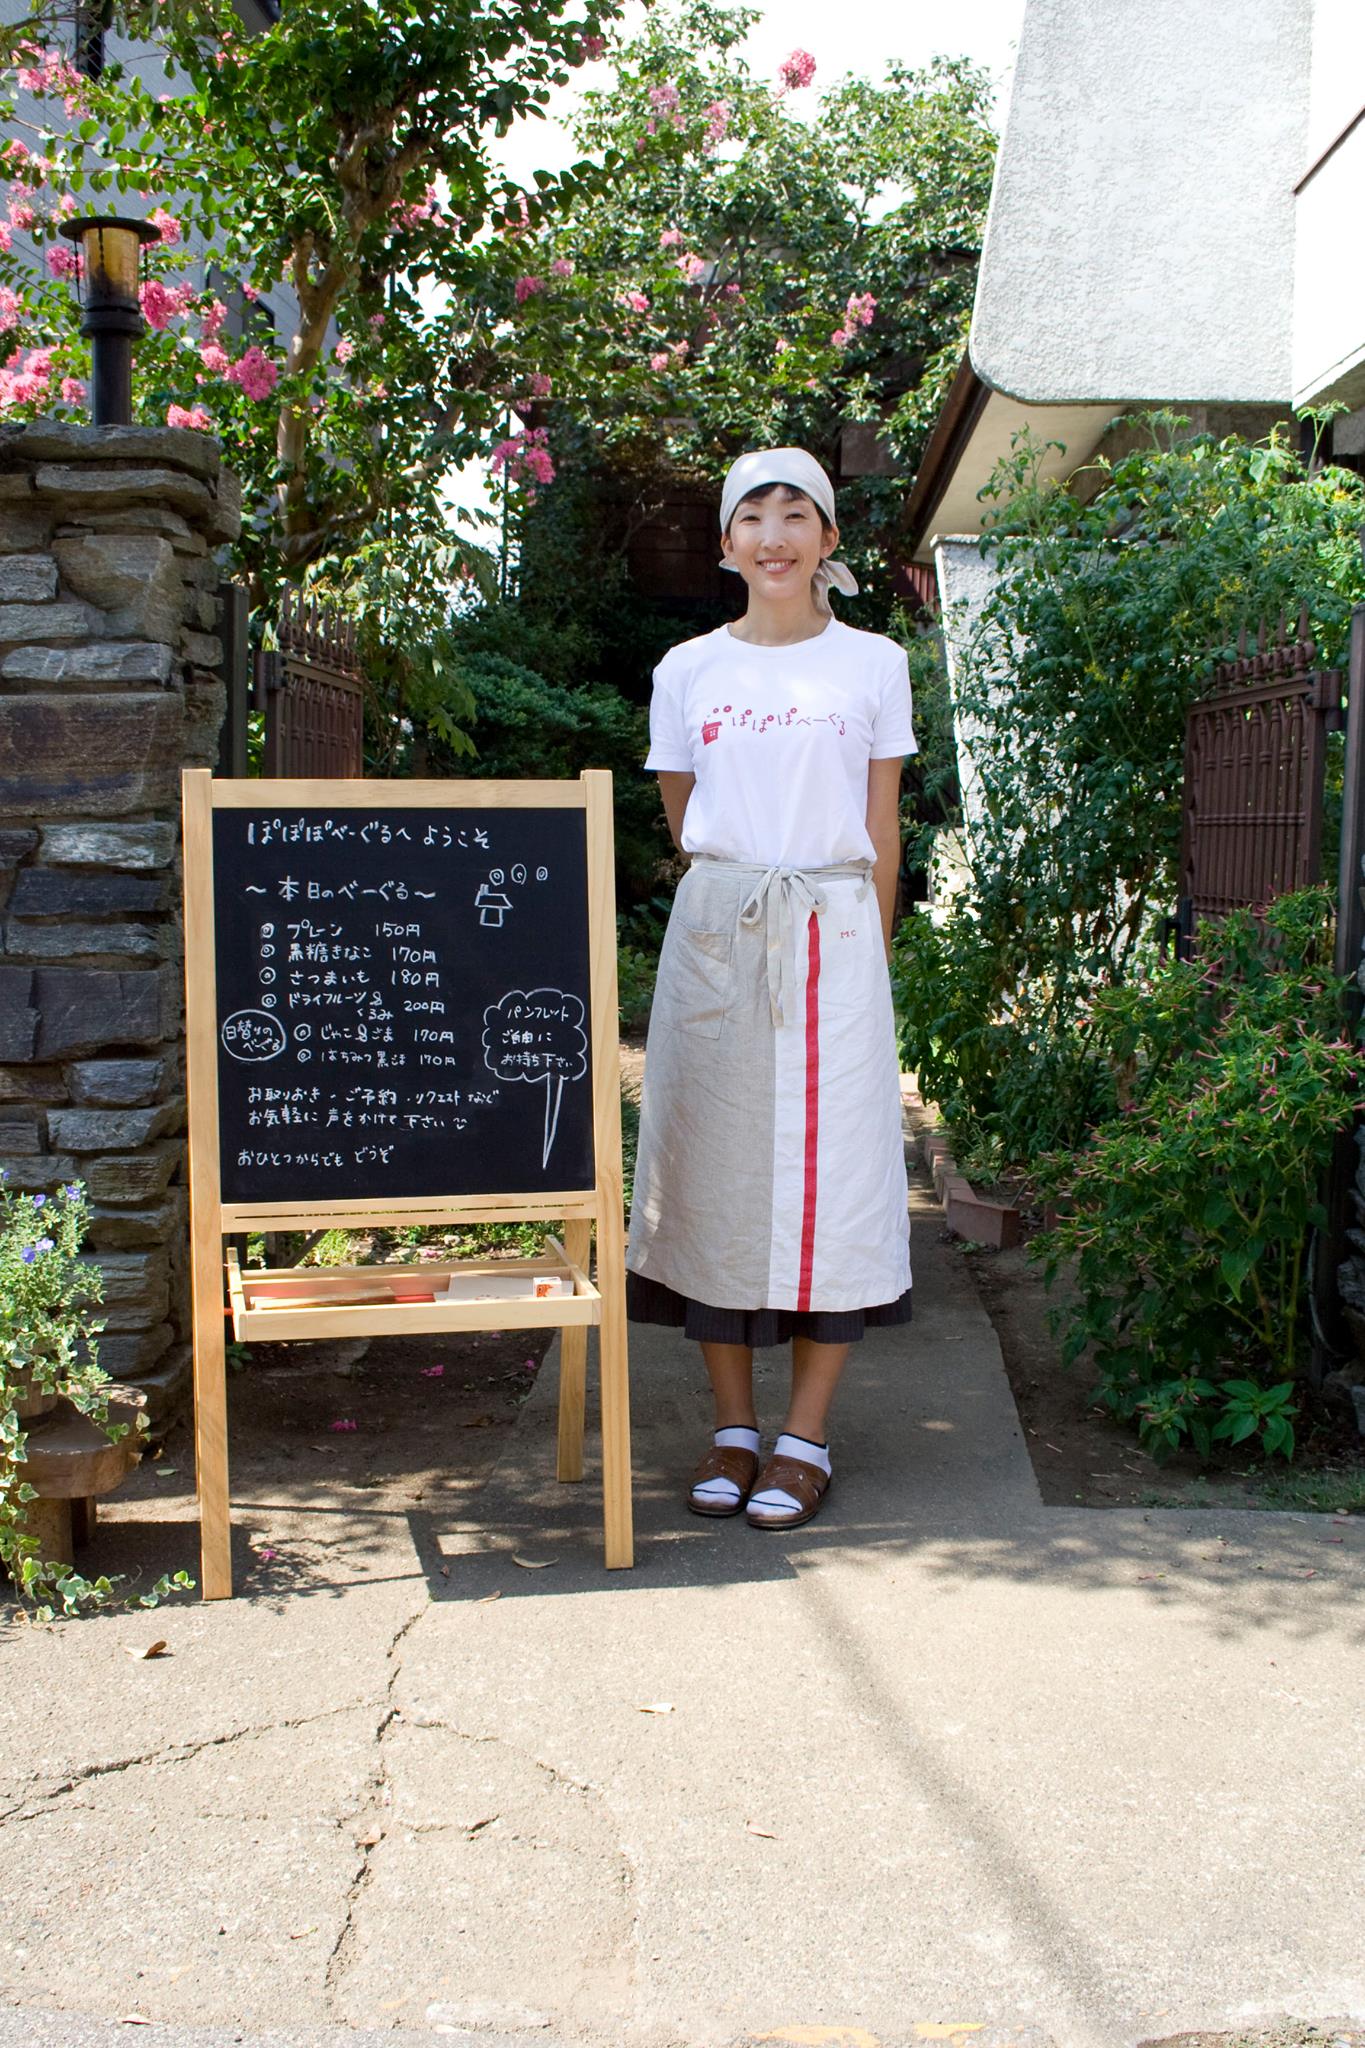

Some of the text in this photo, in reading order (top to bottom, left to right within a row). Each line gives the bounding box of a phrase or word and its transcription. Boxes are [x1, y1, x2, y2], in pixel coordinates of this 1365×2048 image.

[423, 825, 490, 849] ようこそ
[287, 919, 420, 939] プレーン 150円
[288, 941, 437, 963] 黒糖きなこ 170円
[290, 969, 439, 988] さつまいも 180円
[403, 1000, 445, 1014] 200円
[507, 1005, 569, 1022] パンフレット
[414, 1029, 454, 1043] 170円
[502, 1028, 553, 1044] ご自由に
[420, 1054, 456, 1066] 170円
[500, 1051, 573, 1068] お持ち下さい
